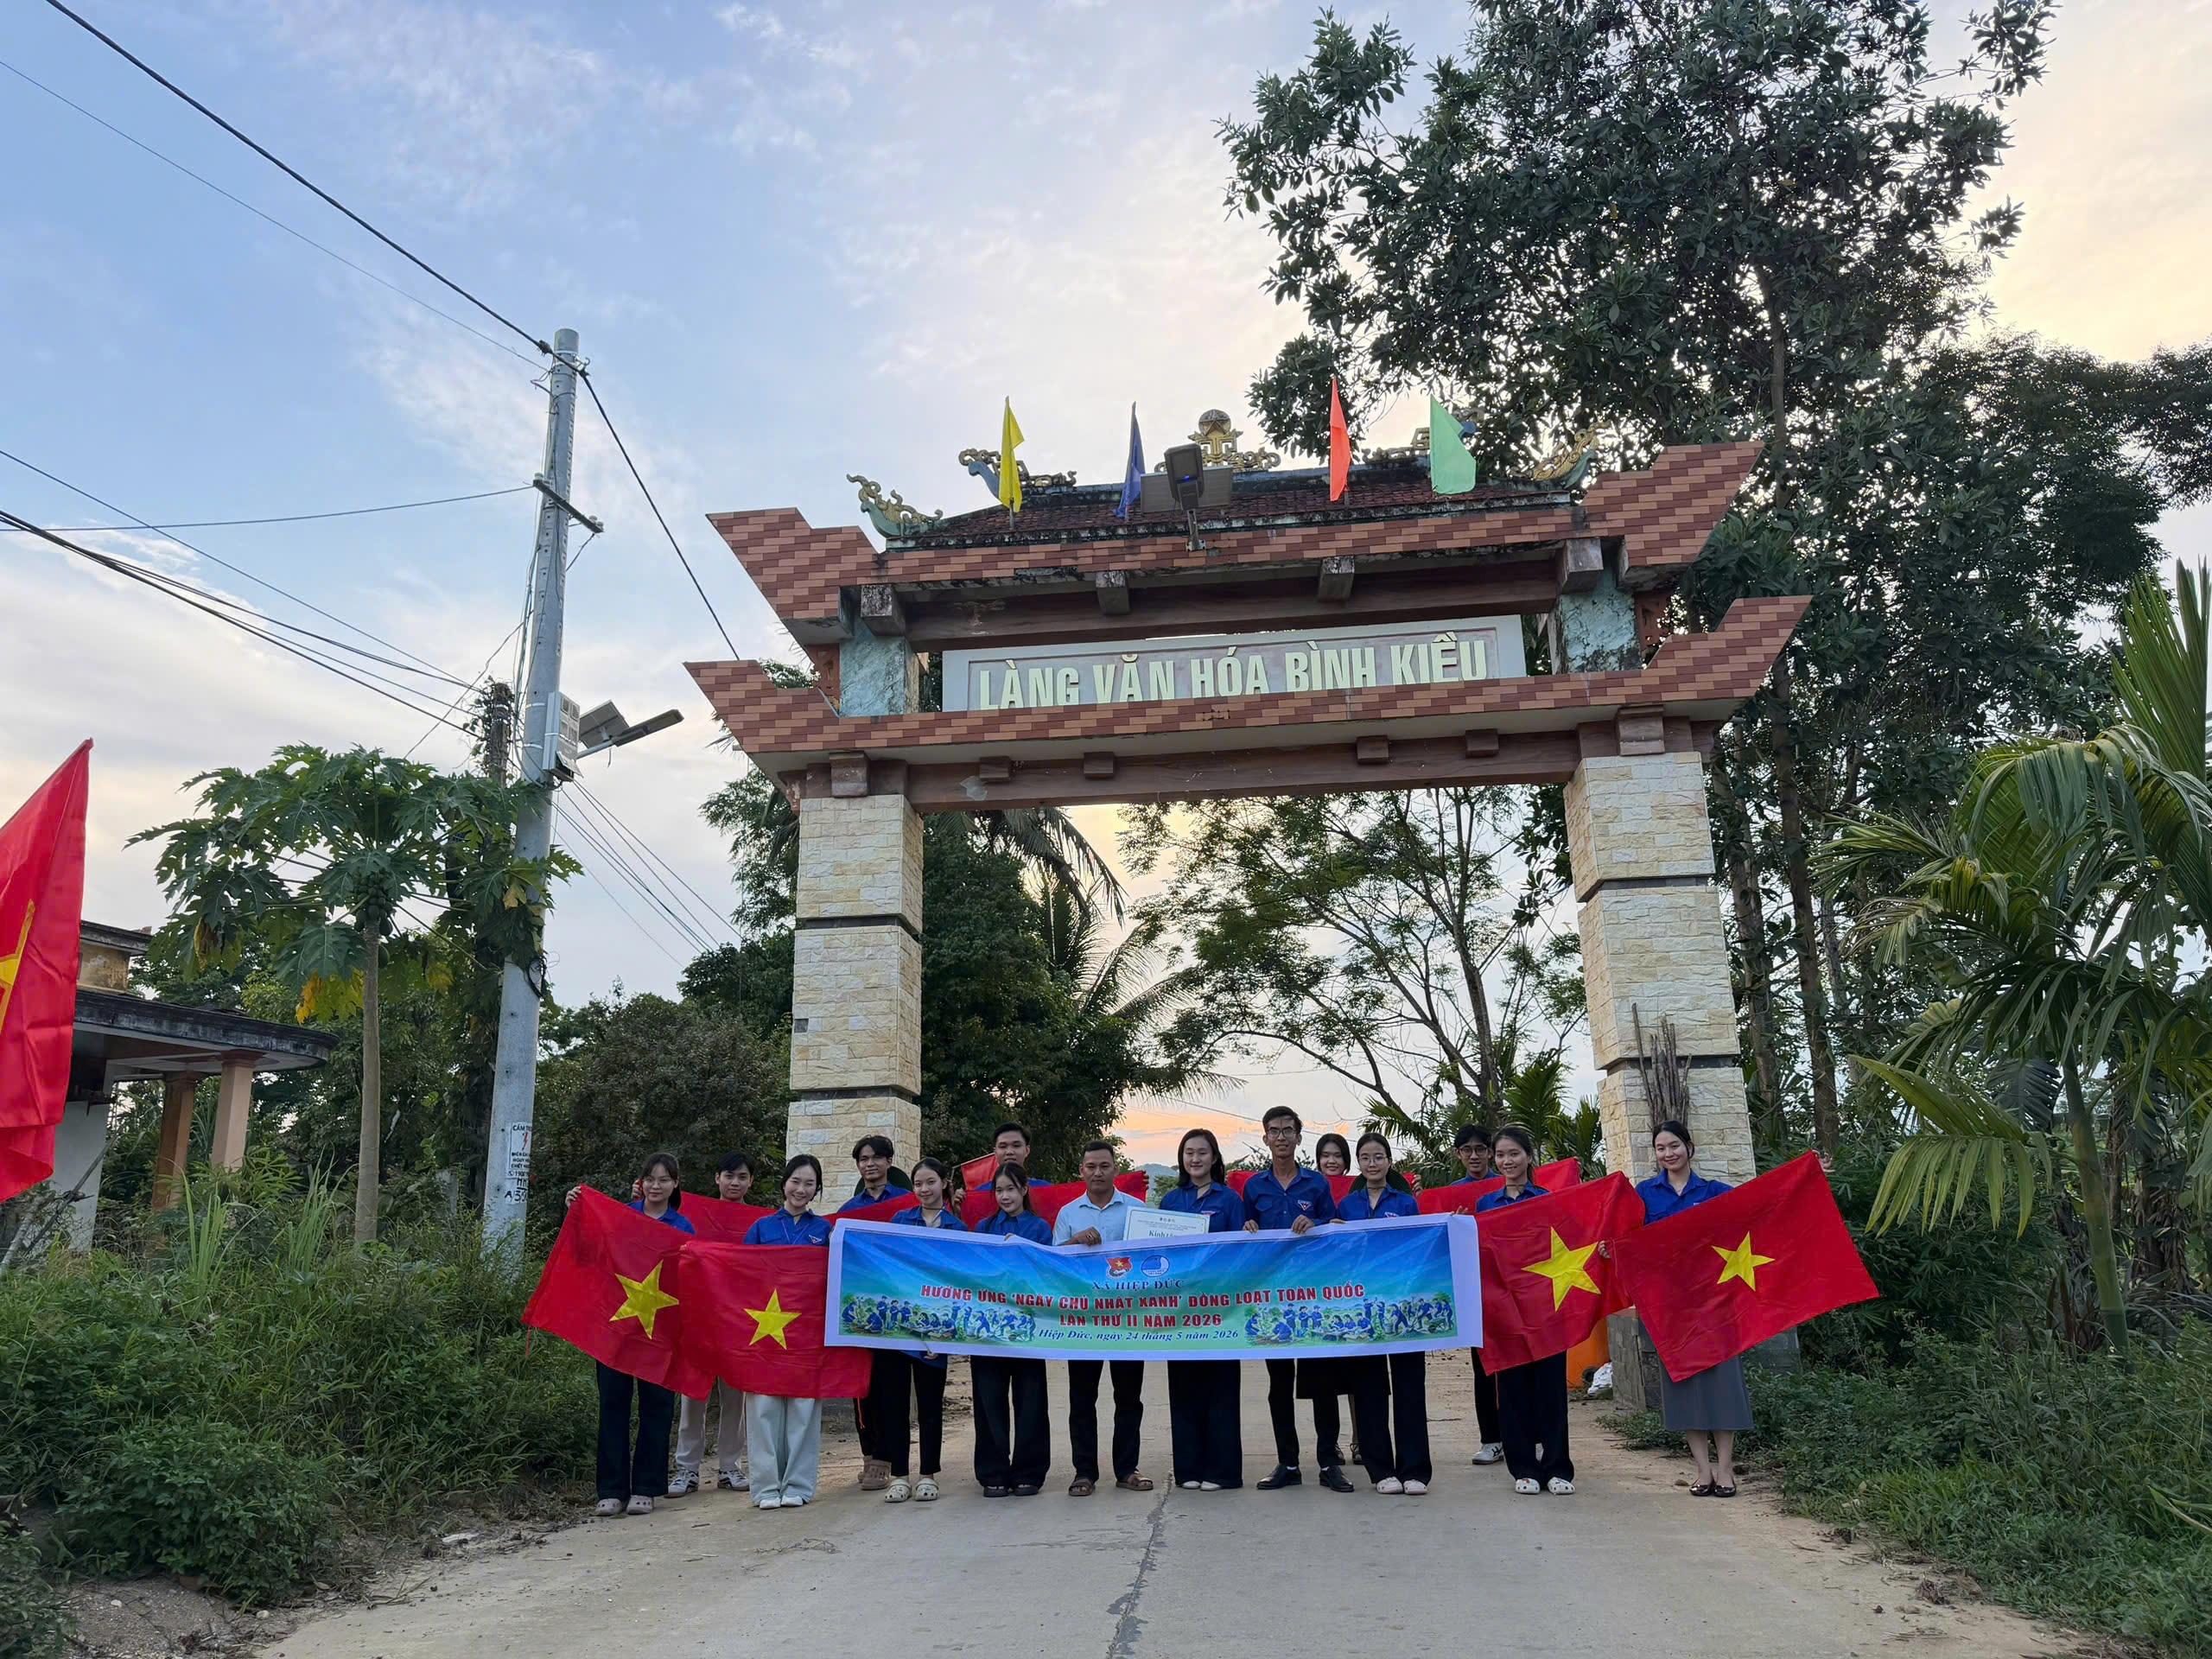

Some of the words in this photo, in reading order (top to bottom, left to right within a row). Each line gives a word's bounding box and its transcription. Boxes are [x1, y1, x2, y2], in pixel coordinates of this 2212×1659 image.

[980, 659, 1079, 710] LÀNG
[1092, 653, 1176, 703] VĂN
[1190, 646, 1270, 699] HÓA
[1285, 640, 1376, 692] BÌNH
[1390, 632, 1487, 685] KIỀU
[1116, 1281, 1149, 1291] HIỆP
[1058, 1294, 1089, 1310] CHỦ
[1095, 1296, 1133, 1311] NHẬT
[1188, 1292, 1230, 1307] ĐỒNG
[1236, 1290, 1271, 1306] LOẠT
[1277, 1286, 1317, 1302] TOÀN
[1323, 1281, 1364, 1300] QUỐC
[1092, 1313, 1122, 1326] THỨ
[1127, 1314, 1138, 1327] II
[1144, 1313, 1176, 1327] NĂM
[1182, 1313, 1222, 1326] 2026
[1039, 1330, 1065, 1340] Hiệp
[1096, 1332, 1122, 1341] ngày
[1126, 1332, 1139, 1340] 24
[1141, 1331, 1173, 1341] tháng
[1212, 1330, 1238, 1339] 2026
